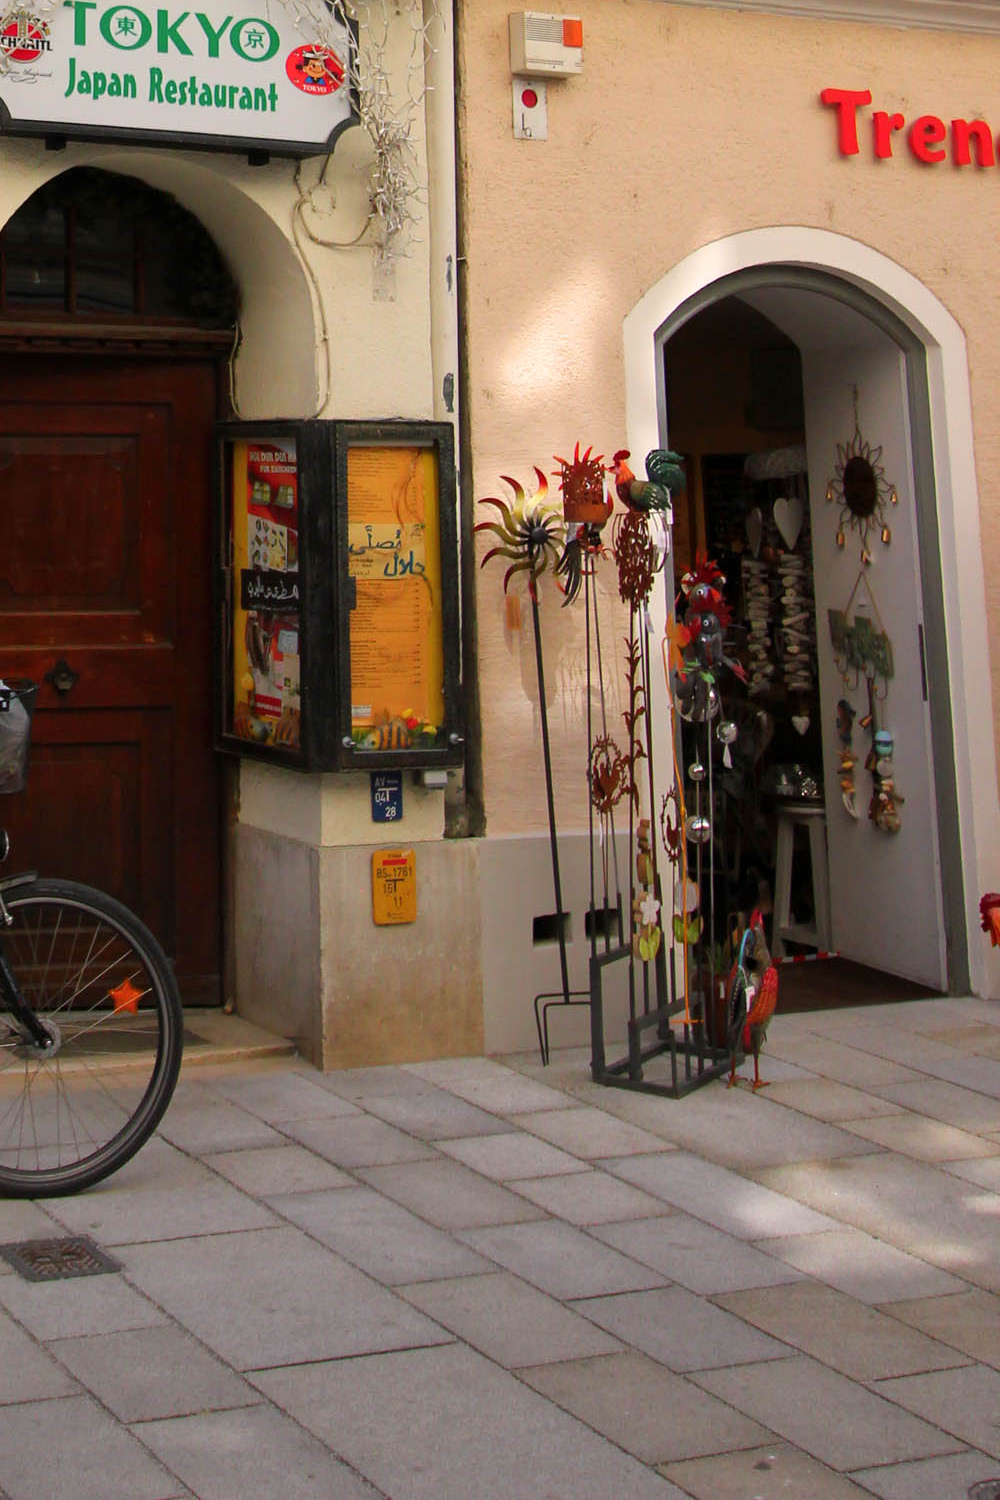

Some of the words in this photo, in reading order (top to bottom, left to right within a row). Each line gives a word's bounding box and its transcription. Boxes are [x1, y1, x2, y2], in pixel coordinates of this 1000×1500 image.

[63, 0, 281, 64] TOKYO
[114, 15, 139, 37] 東
[243, 28, 266, 50] 京
[64, 57, 137, 100] Japan
[149, 66, 279, 113] Restaurant
[302, 83, 327, 93] TOKYO
[819, 88, 1000, 169] Tren
